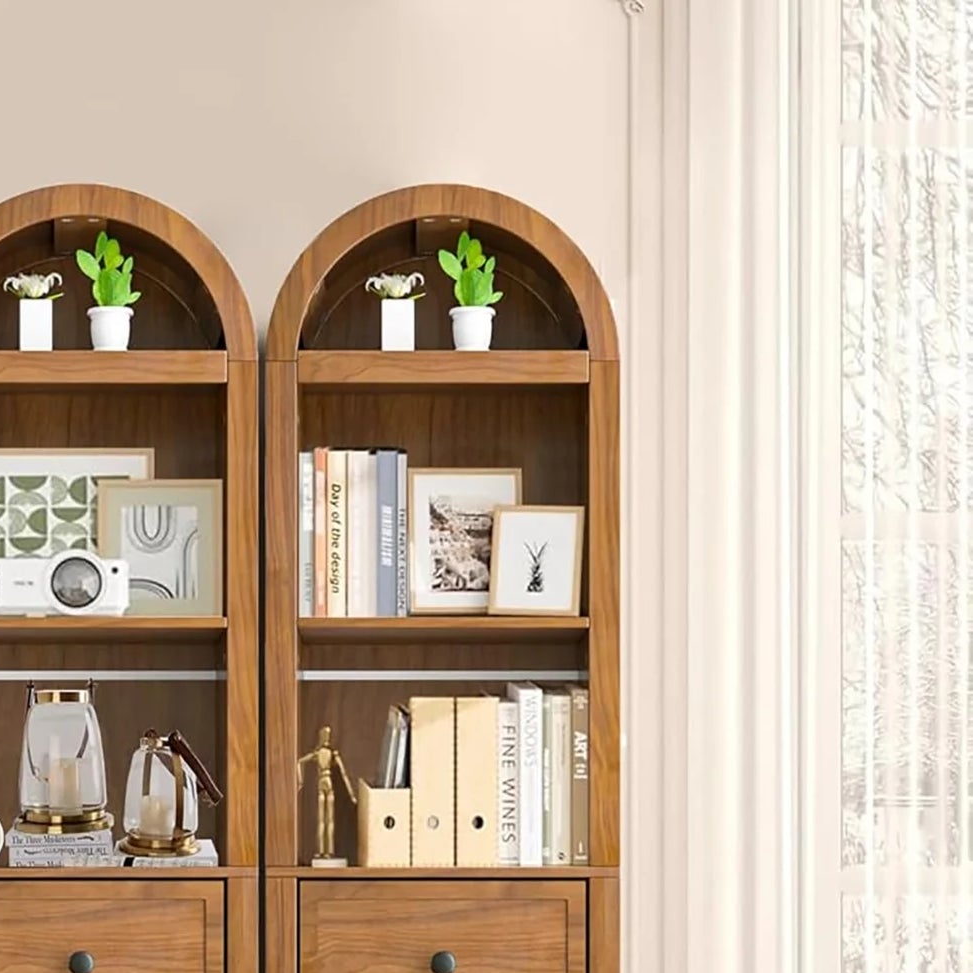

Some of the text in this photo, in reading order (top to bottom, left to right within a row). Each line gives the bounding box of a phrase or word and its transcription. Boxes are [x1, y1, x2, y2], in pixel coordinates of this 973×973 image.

[329, 483, 342, 594] Day of the design
[501, 725, 516, 844] FINE WINES
[523, 695, 538, 768] WINDOWS
